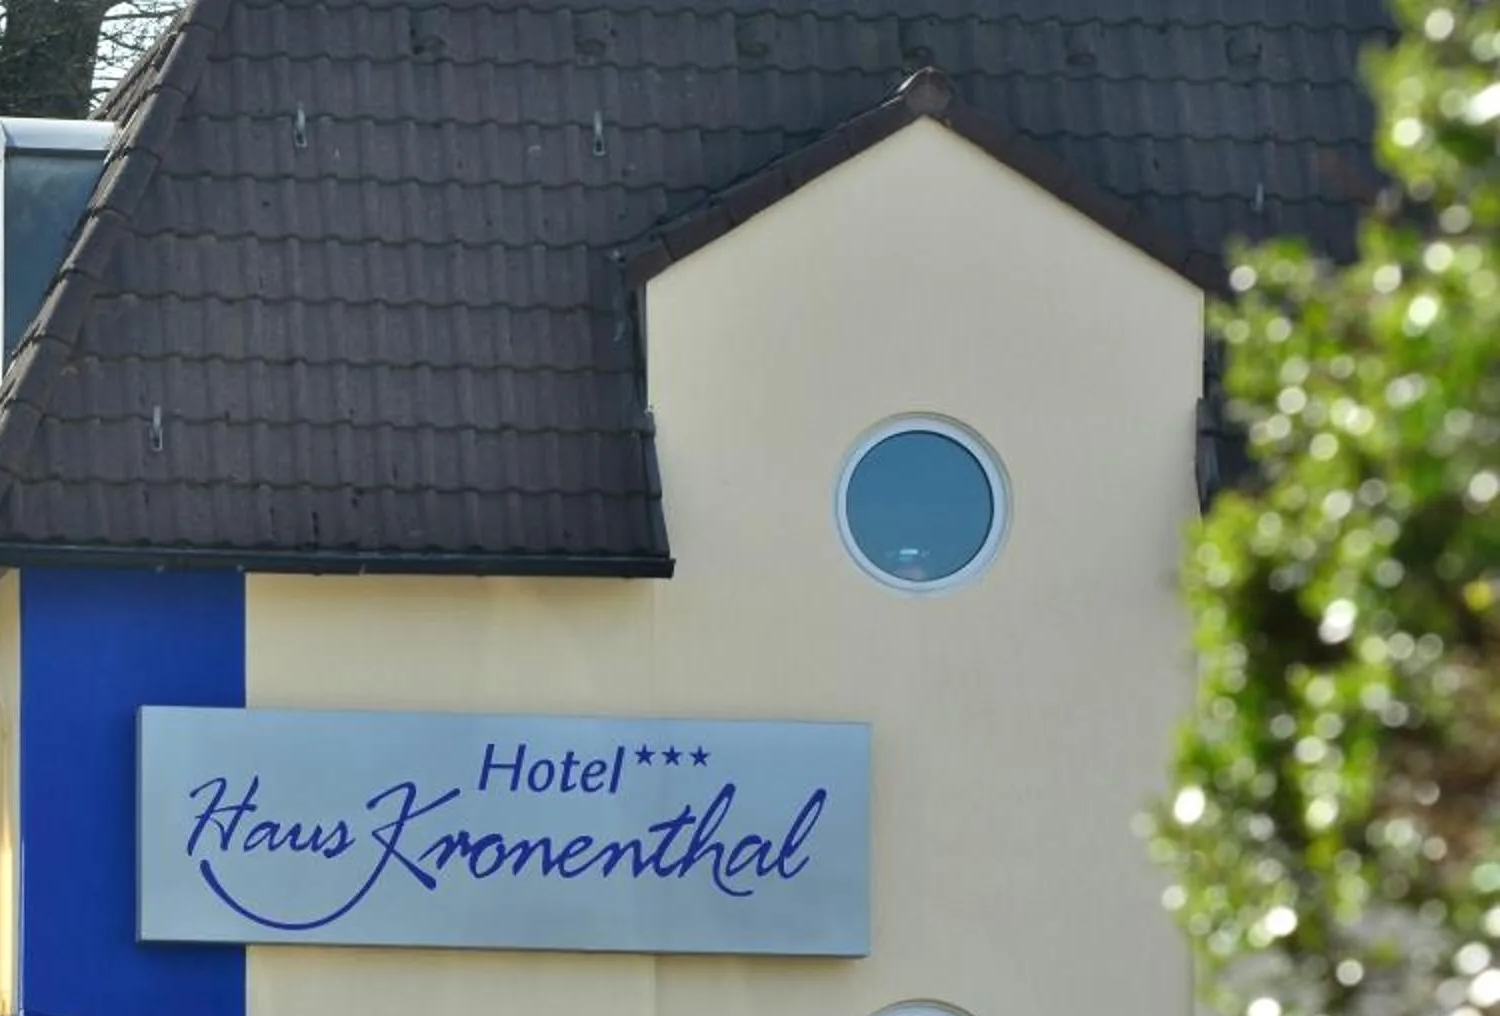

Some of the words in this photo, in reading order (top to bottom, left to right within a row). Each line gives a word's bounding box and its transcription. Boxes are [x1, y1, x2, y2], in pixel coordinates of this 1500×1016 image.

[479, 743, 626, 793] Hotel
[187, 776, 356, 856] Haus
[366, 781, 828, 897] Kronenthal
